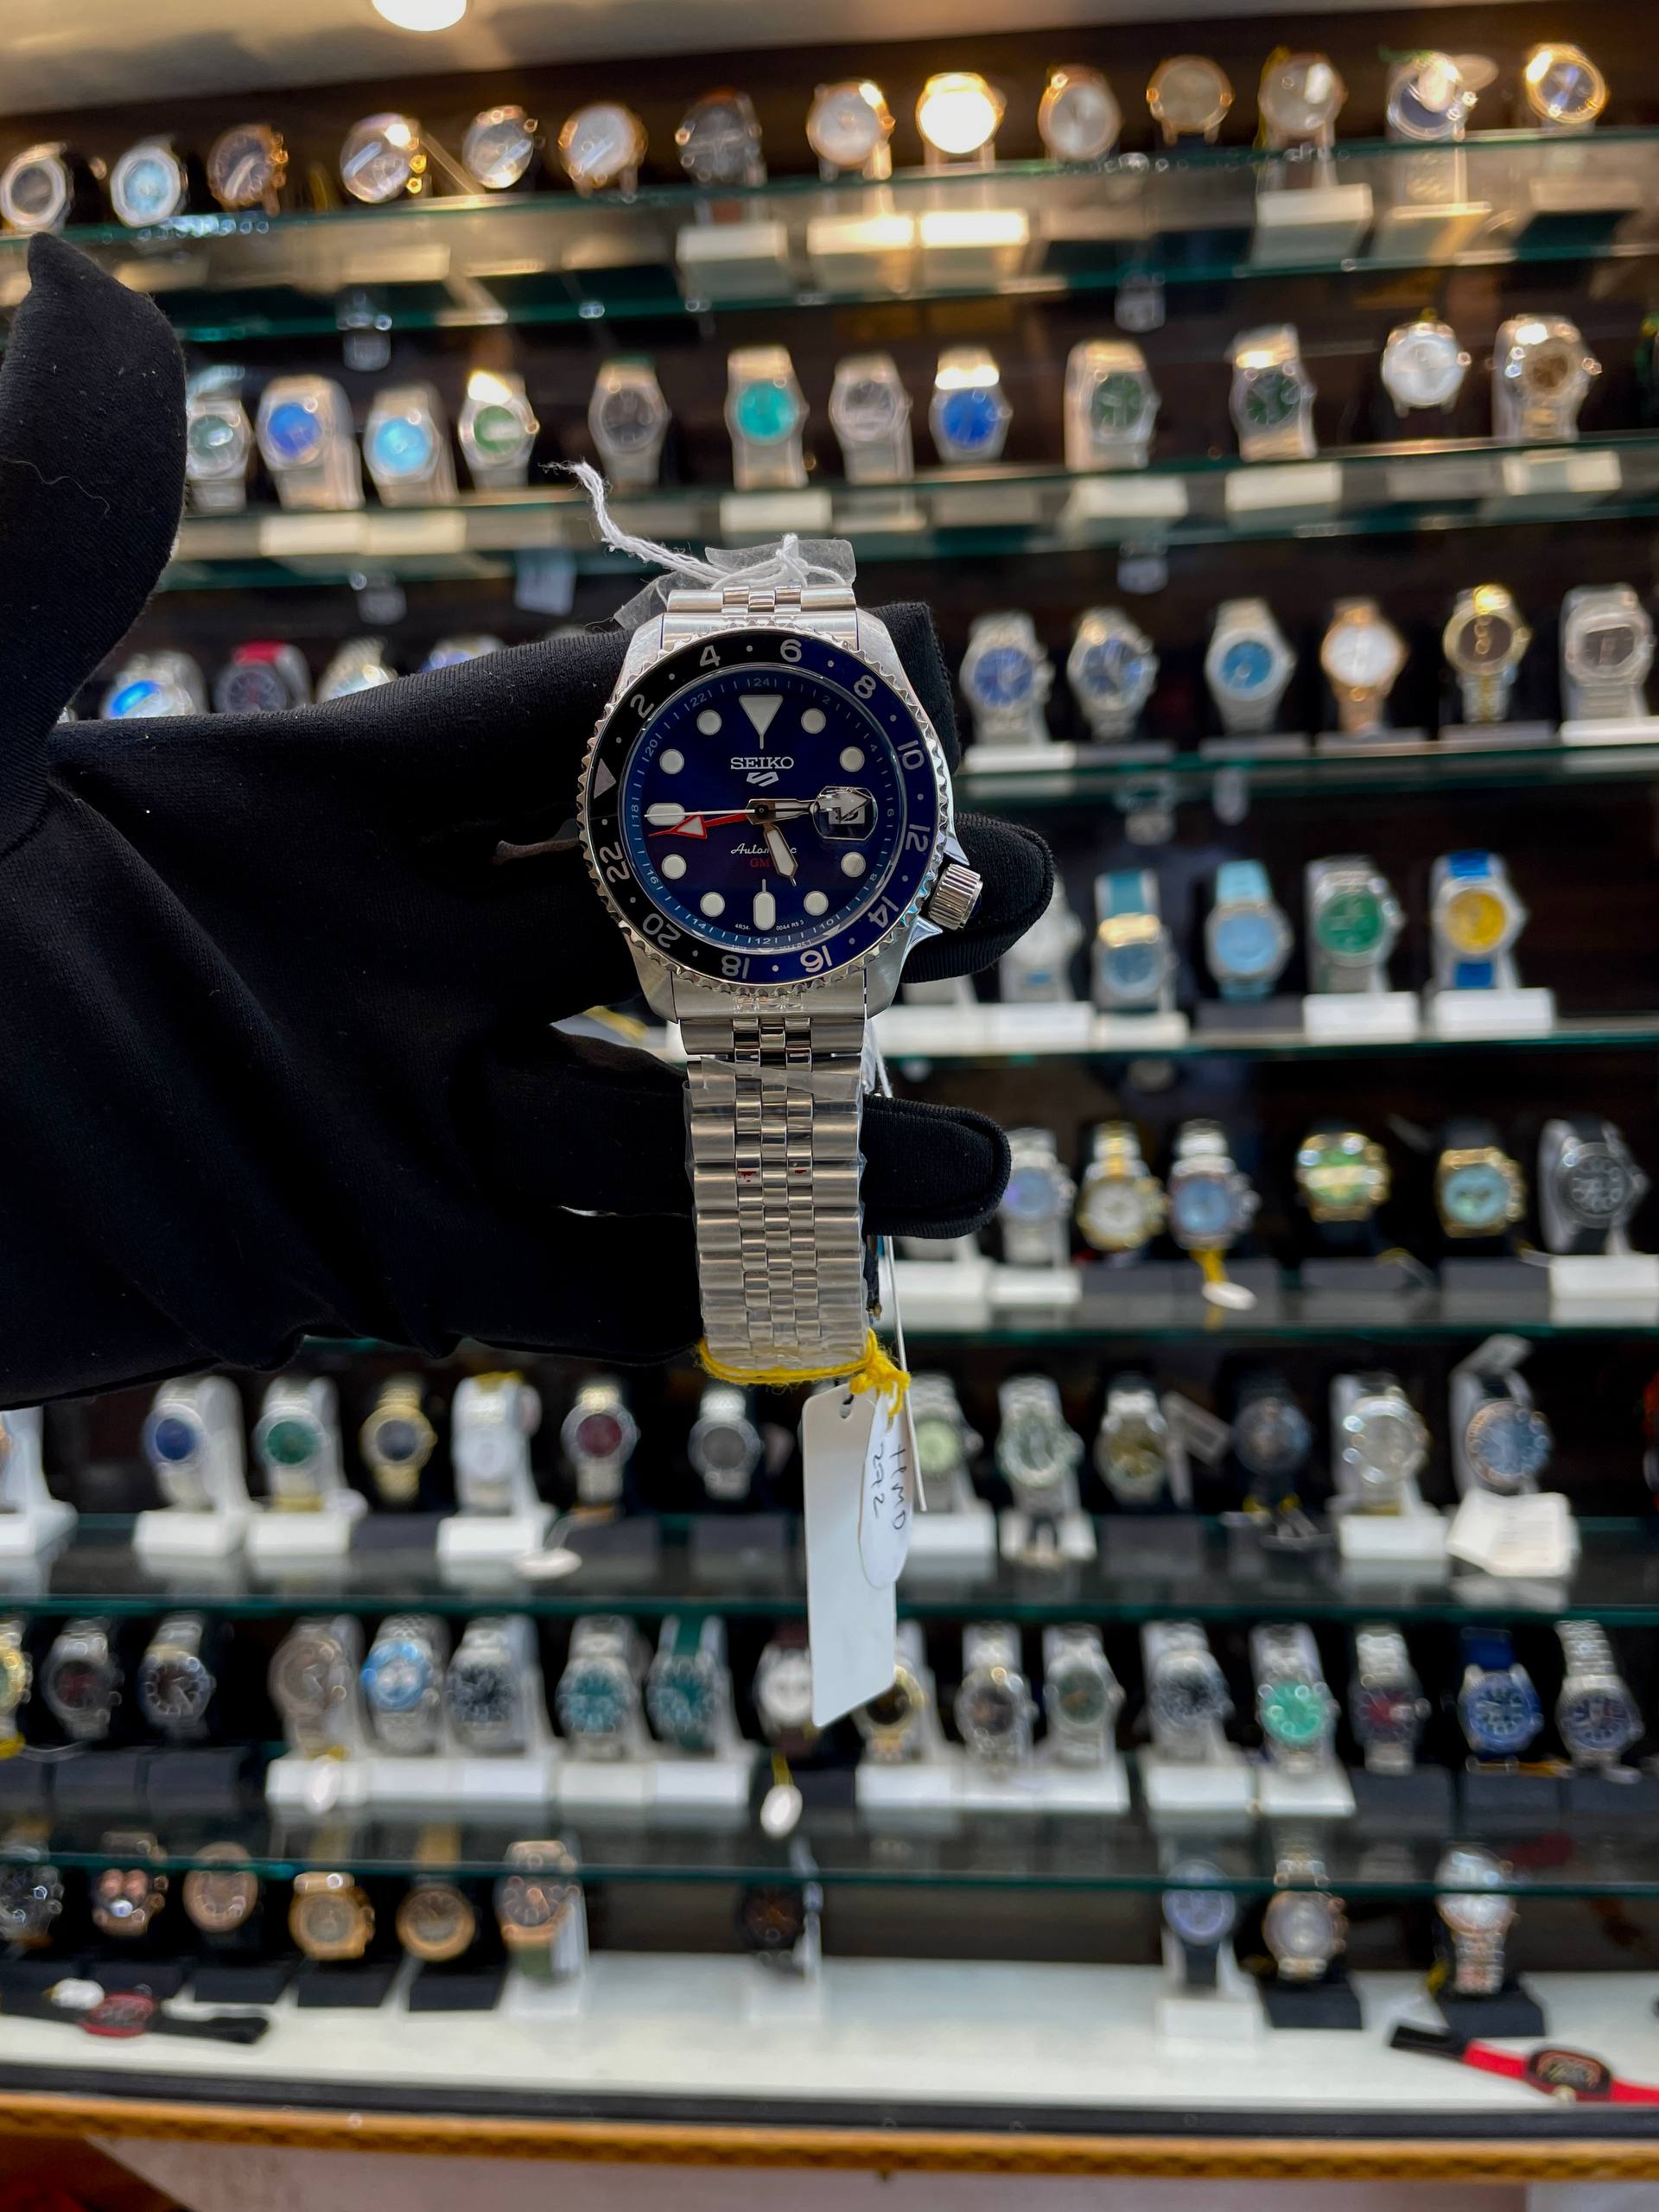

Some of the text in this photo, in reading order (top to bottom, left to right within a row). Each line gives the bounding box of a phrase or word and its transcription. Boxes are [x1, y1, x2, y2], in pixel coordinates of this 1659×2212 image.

[700, 645, 721, 667] 4
[780, 639, 802, 663] 6
[753, 677, 771, 687] 24
[854, 675, 876, 699] 8
[630, 694, 654, 719] 2
[690, 693, 708, 708] 22
[823, 696, 830, 704] 2
[645, 740, 658, 757] 20
[869, 743, 878, 753] 4
[897, 740, 925, 770] 10
[730, 756, 794, 770] SEIKO
[631, 804, 639, 820] 18
[905, 823, 931, 852] 12
[600, 842, 630, 883] 22
[646, 869, 658, 885] 16
[869, 873, 878, 881] 8
[868, 895, 899, 928] 14
[642, 912, 682, 948] 20
[691, 918, 707, 929] 14
[819, 918, 834, 929] 10
[721, 954, 750, 979] 18
[800, 945, 832, 972] 16
